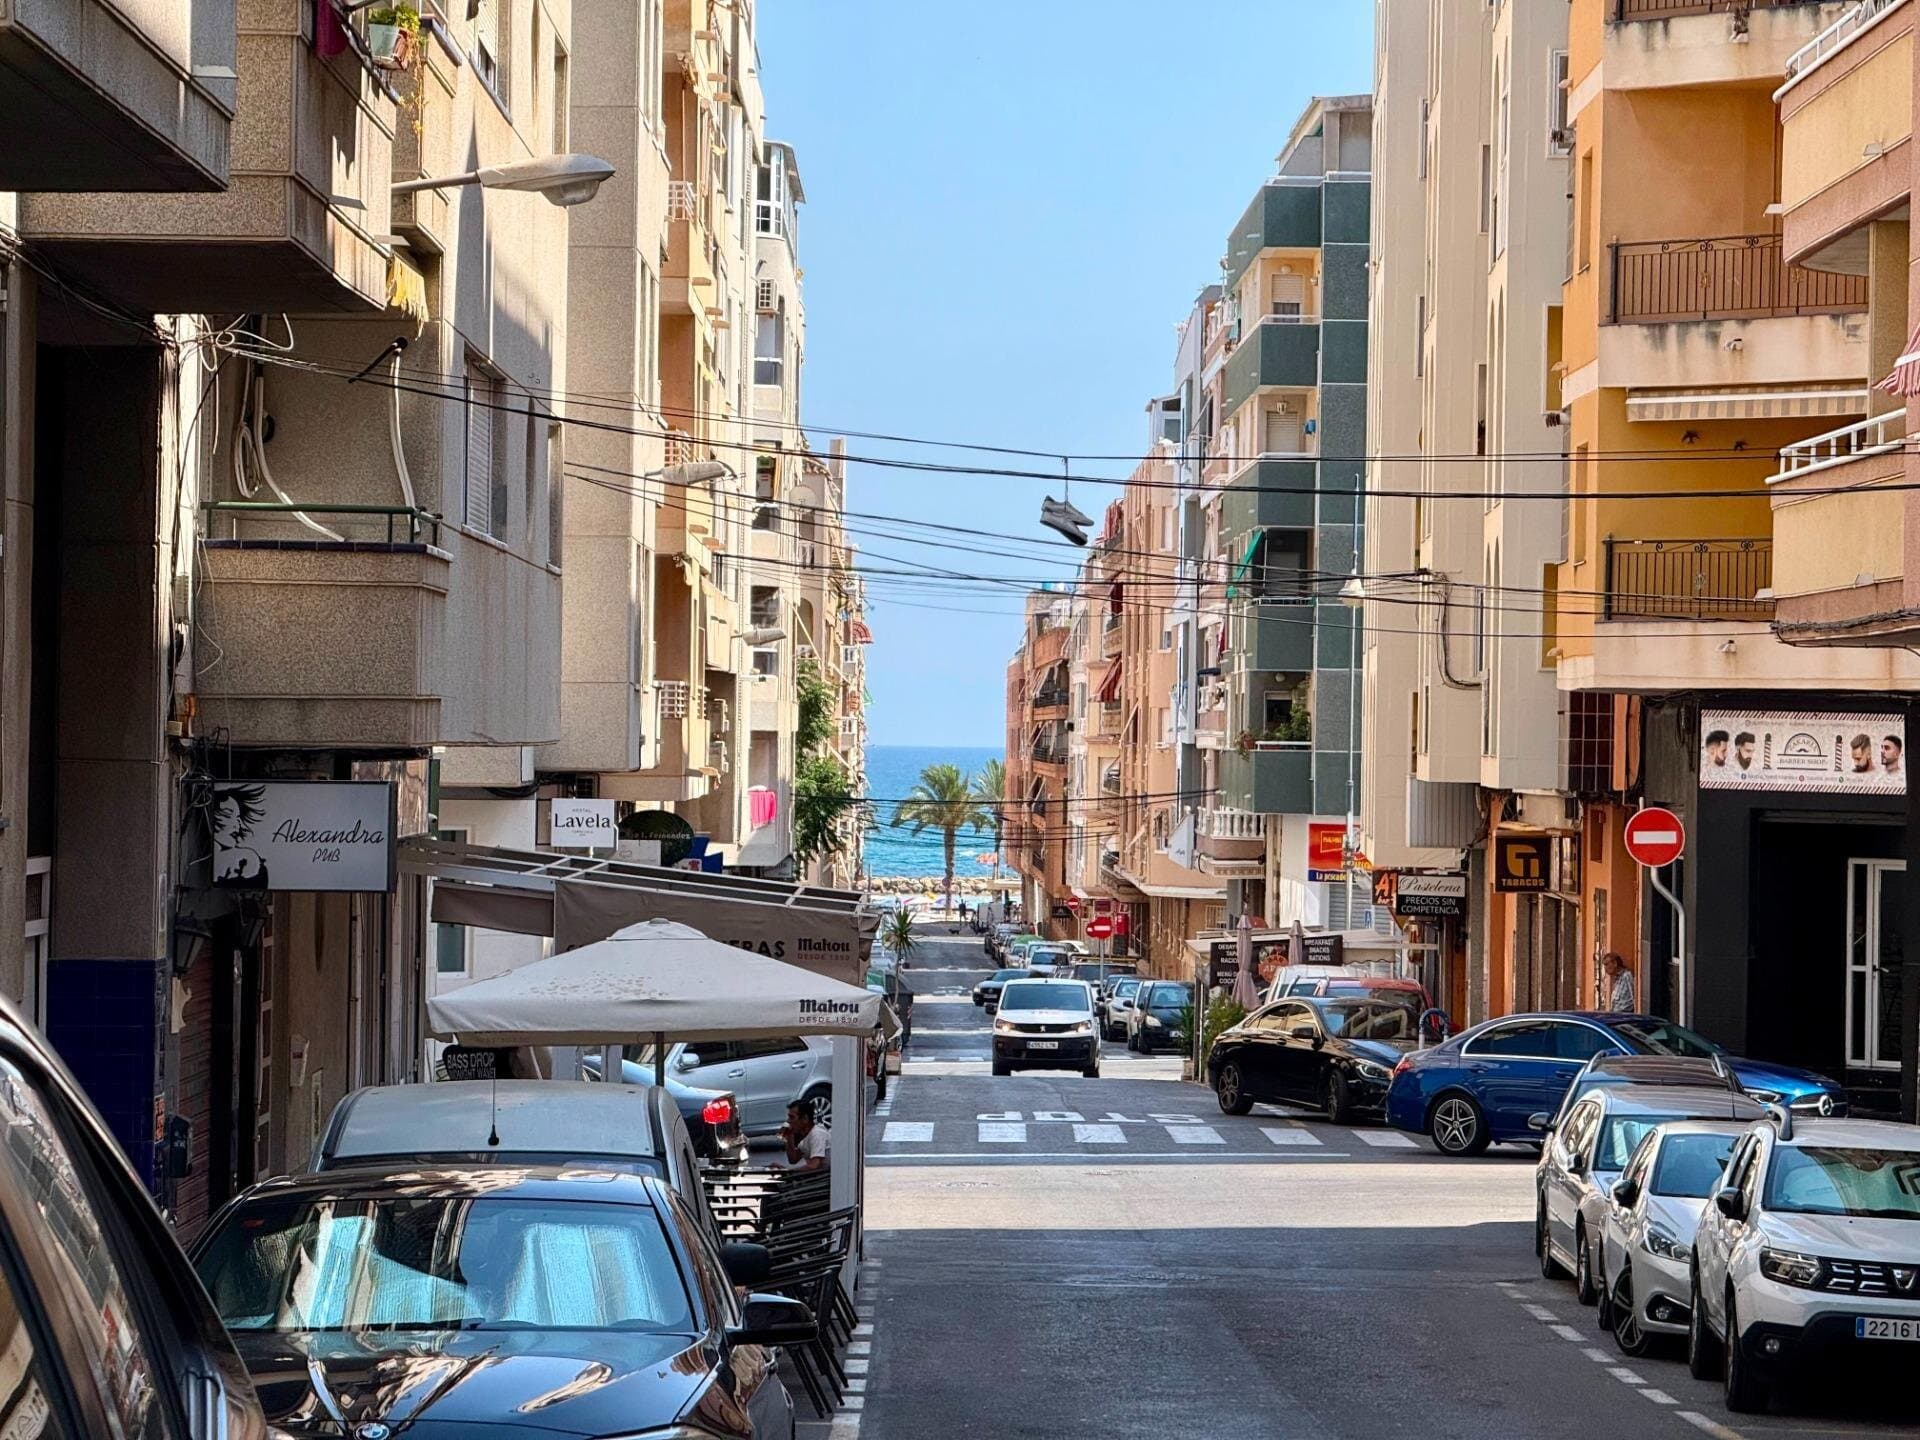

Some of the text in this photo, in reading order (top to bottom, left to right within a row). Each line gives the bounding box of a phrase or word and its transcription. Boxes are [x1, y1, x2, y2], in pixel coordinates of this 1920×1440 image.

[554, 813, 611, 828] Lavela
[272, 819, 384, 844] Alexandra
[312, 849, 341, 862] PUB
[1502, 878, 1545, 887] TABACOS
[1405, 896, 1456, 906] PRECIOS SIN
[1401, 904, 1460, 915] COMPETENCIA
[798, 938, 850, 951] Mahou
[799, 999, 859, 1013] Mahou
[447, 1052, 495, 1069] BASS DROP
[1868, 1320, 1911, 1338] 2216
